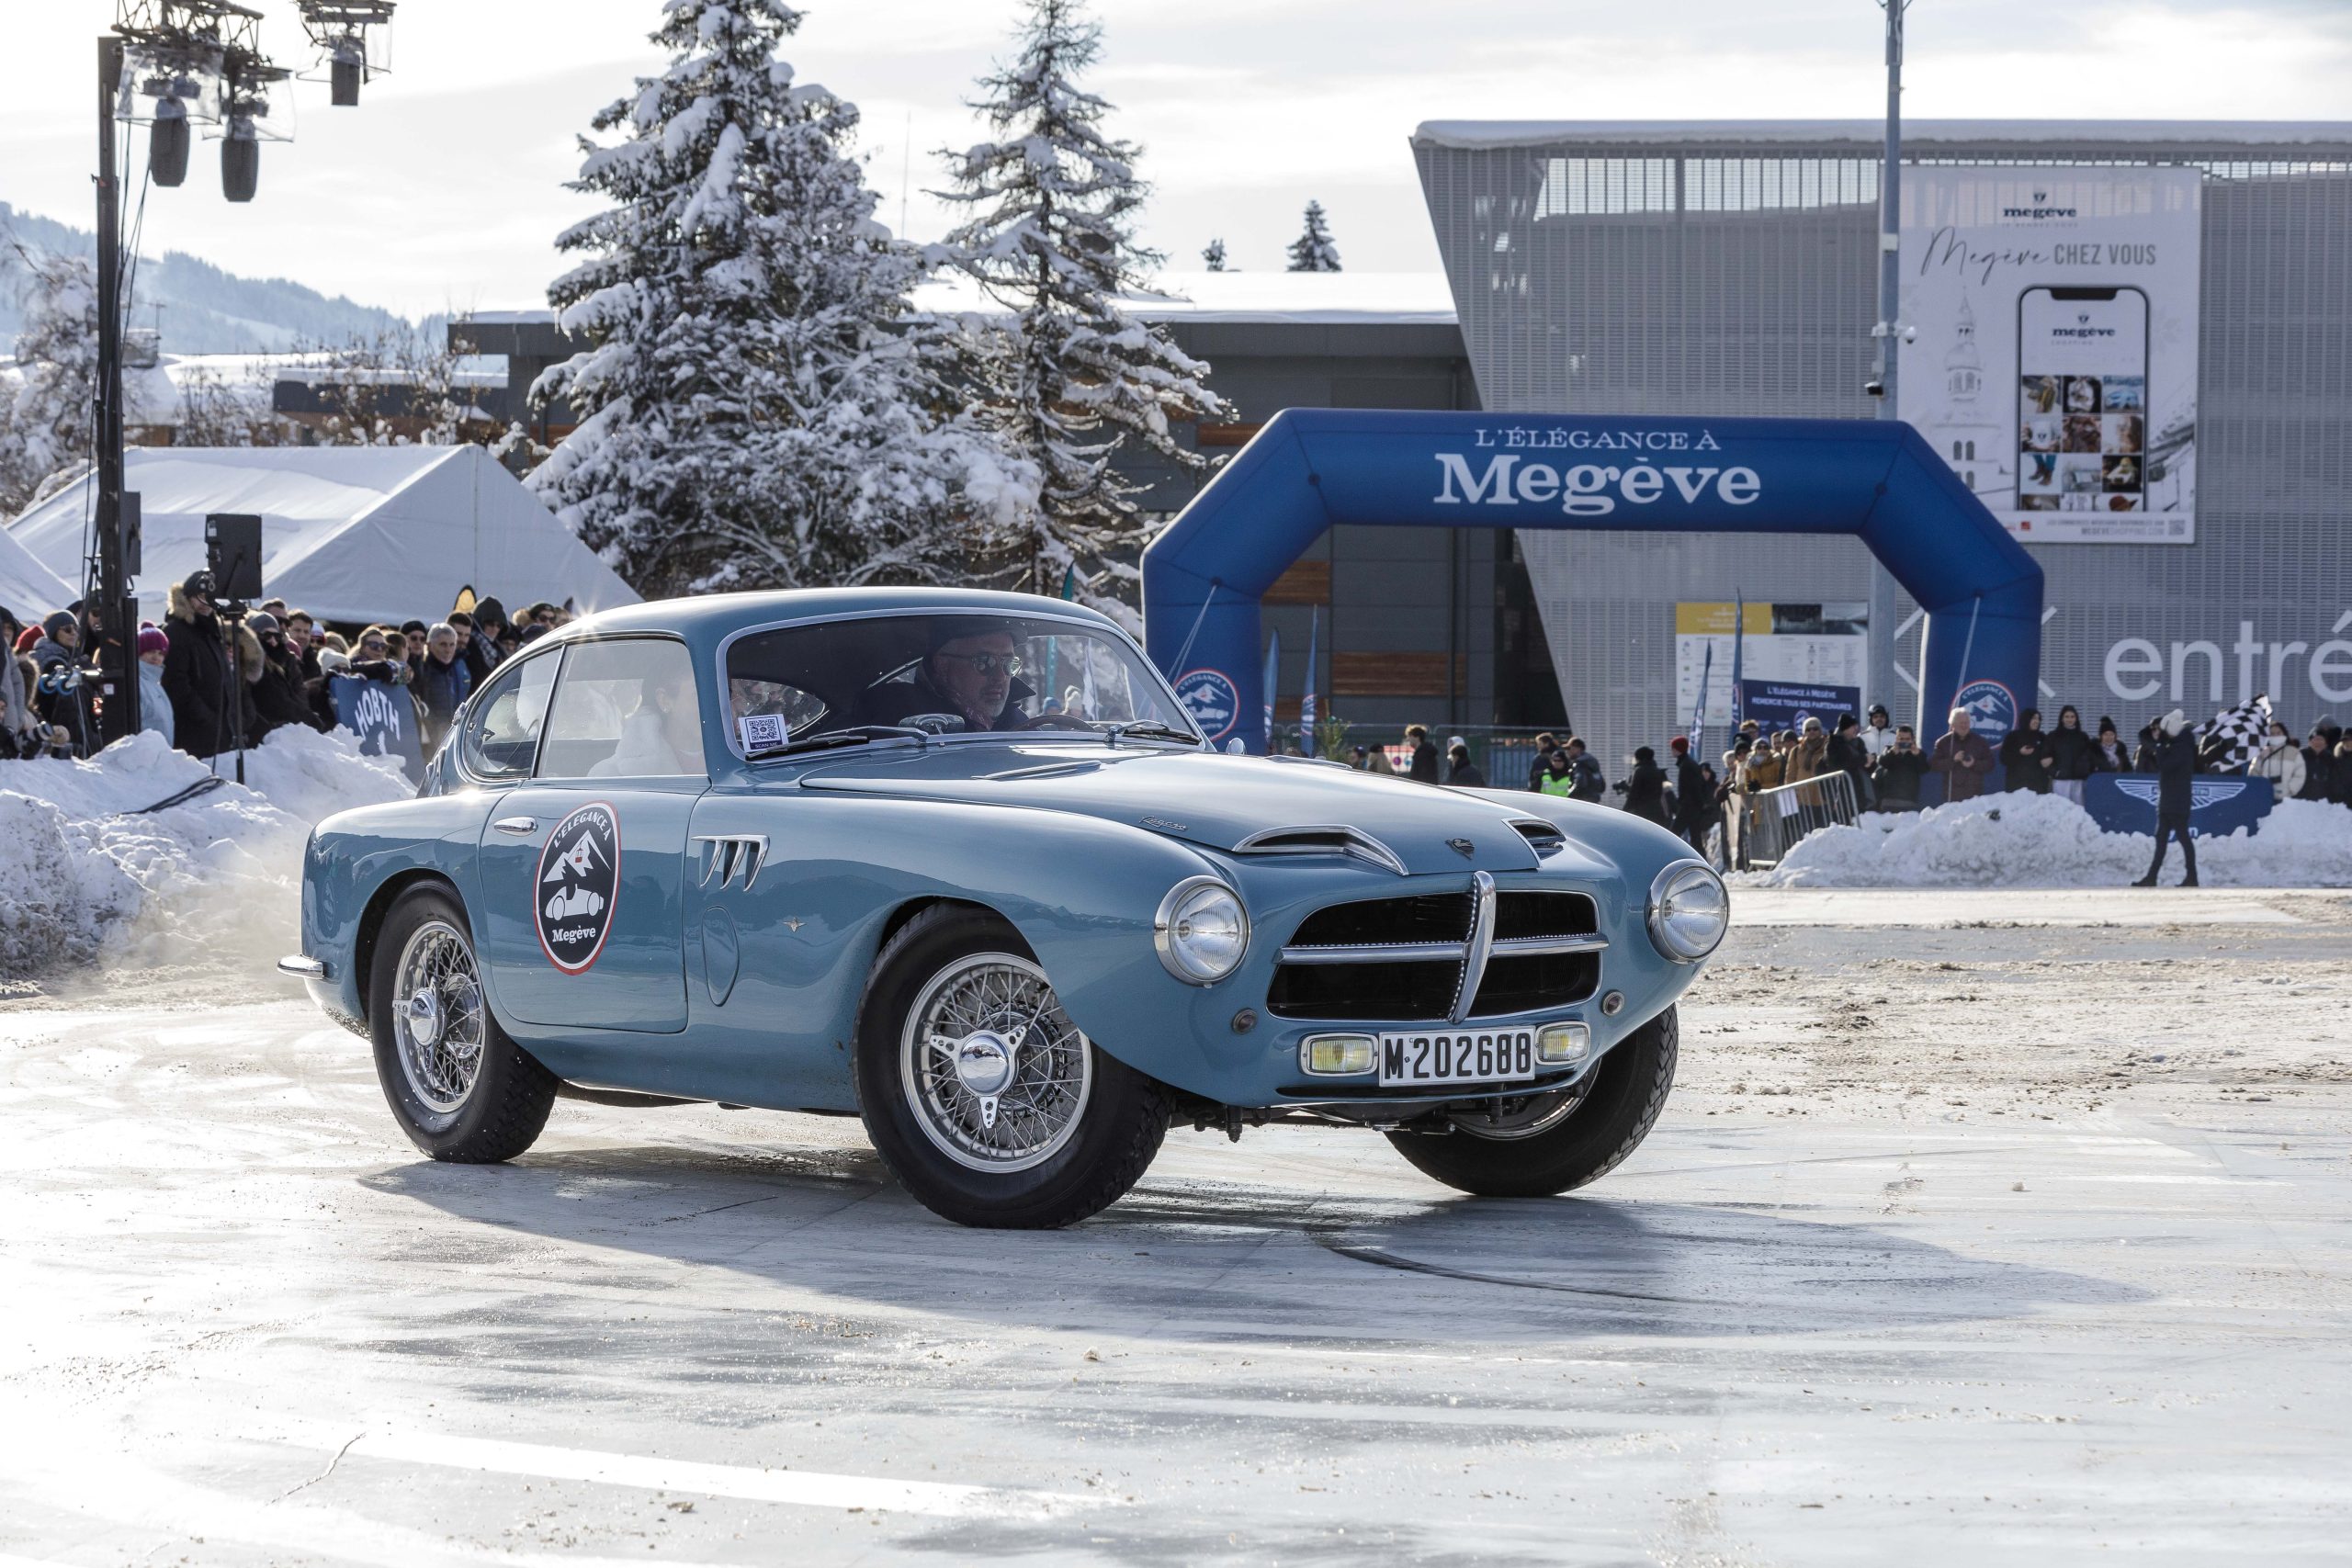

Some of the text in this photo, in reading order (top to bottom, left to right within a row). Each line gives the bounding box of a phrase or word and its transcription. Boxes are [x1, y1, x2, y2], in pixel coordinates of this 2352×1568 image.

[2054, 243, 2102, 265] CHEZ
[2109, 243, 2157, 265] VOUS
[1475, 425, 1723, 450] L'ÉLÉGANCE À
[1433, 453, 1761, 515] Megève
[2103, 609, 2352, 704] entré
[551, 924, 596, 944] Megève
